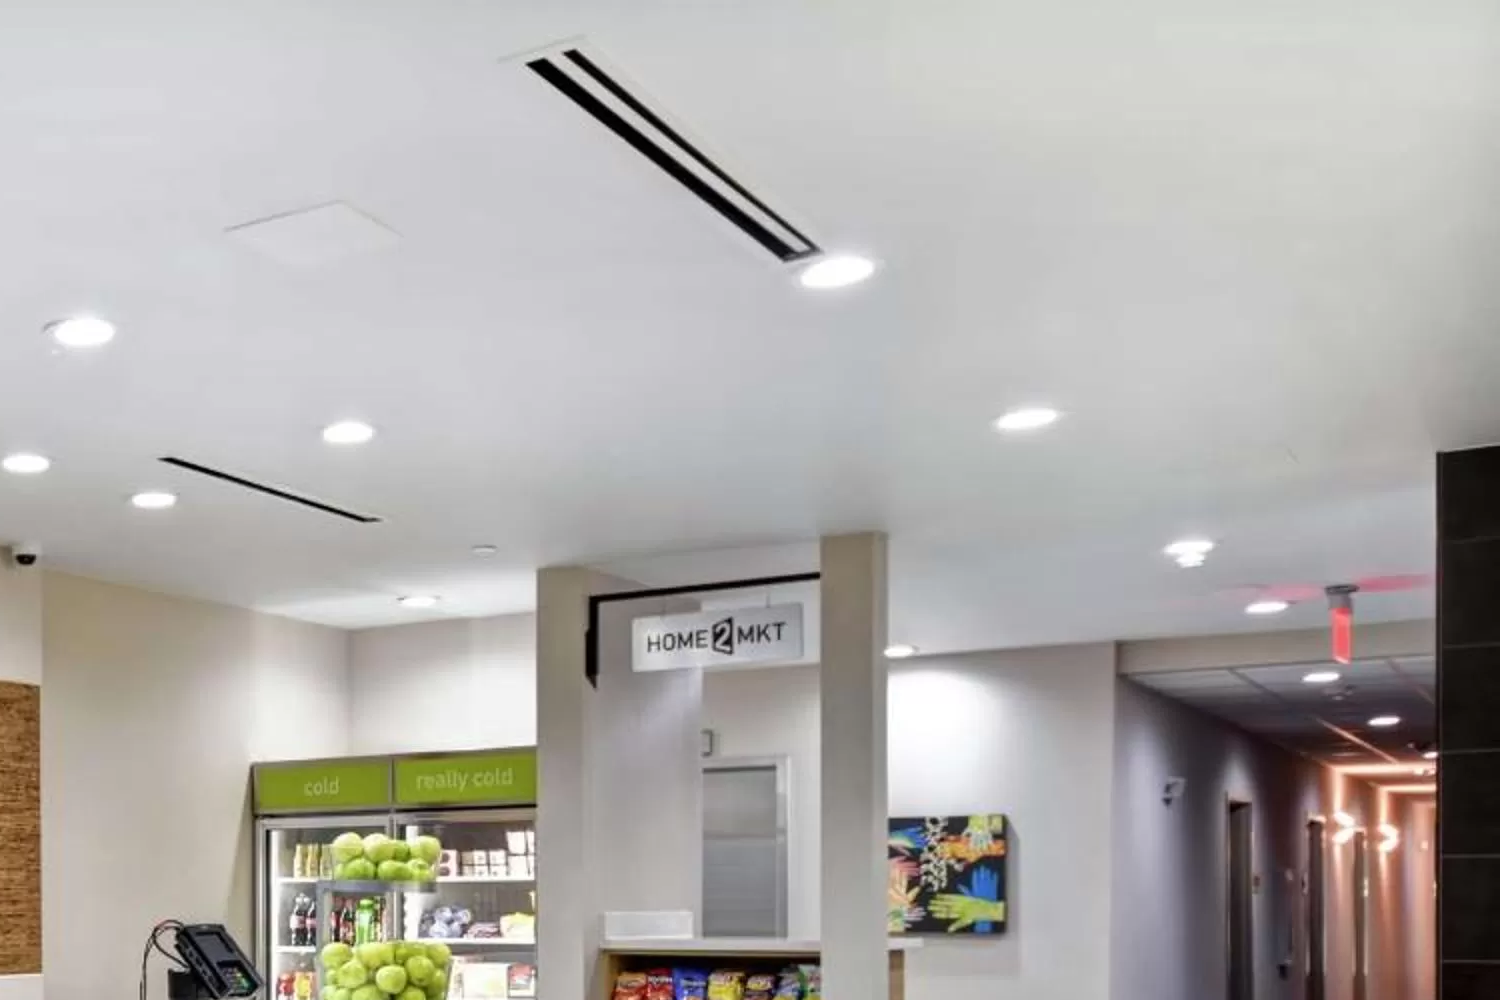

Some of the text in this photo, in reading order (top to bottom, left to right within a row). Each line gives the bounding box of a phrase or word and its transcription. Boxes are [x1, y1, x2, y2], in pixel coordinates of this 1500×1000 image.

[304, 777, 340, 796] cold
[416, 768, 513, 791] really cold
